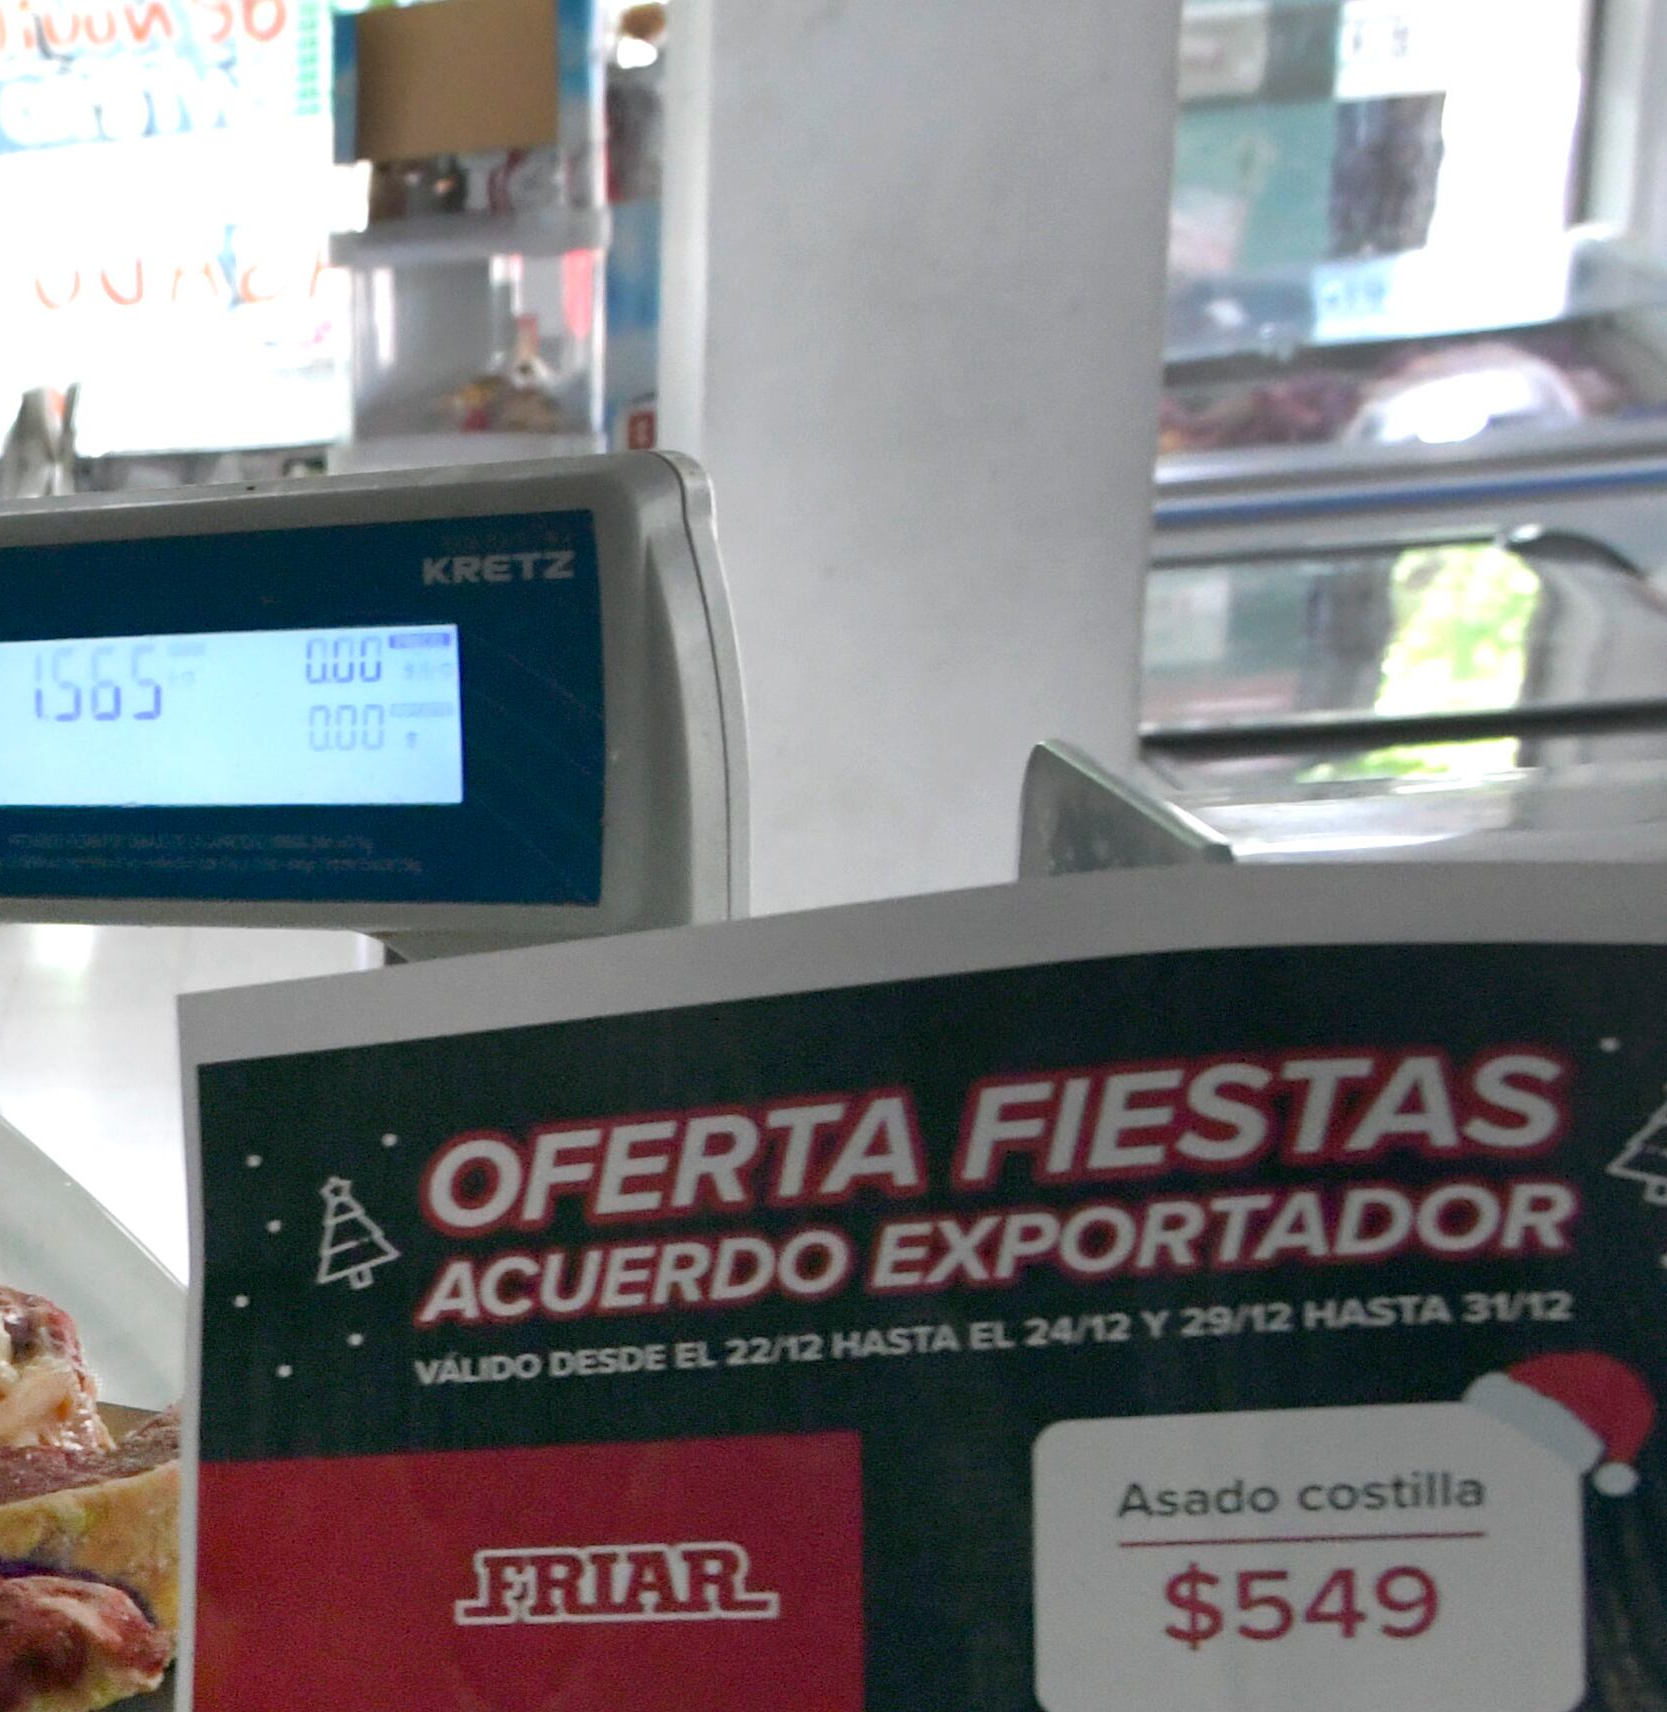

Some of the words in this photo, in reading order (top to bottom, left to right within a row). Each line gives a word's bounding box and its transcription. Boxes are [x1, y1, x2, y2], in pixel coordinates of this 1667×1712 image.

[422, 551, 575, 585] KRETZ
[427, 1096, 919, 1229] OFERTA
[962, 1053, 1563, 1182] FIESTAS
[420, 1229, 847, 1323] ACUERDO
[872, 1183, 1571, 1288] EXPORTADOR
[415, 1349, 540, 1385] VÁLIDO
[548, 1342, 667, 1379] DESDE
[675, 1341, 716, 1371] EL
[725, 1334, 824, 1367] 22/12
[831, 1324, 961, 1360] HASTA
[970, 1320, 1014, 1350] EL
[1024, 1313, 1129, 1346] 24/12
[1142, 1310, 1171, 1338] Y
[1179, 1302, 1292, 1337] 29/12
[1303, 1294, 1450, 1328] HASTA
[1461, 1290, 1572, 1322] 31/12
[1117, 1481, 1280, 1519] Asado
[1297, 1472, 1485, 1514] costilla
[455, 1542, 778, 1626] FRIAR
[1163, 1562, 1439, 1651] $549
